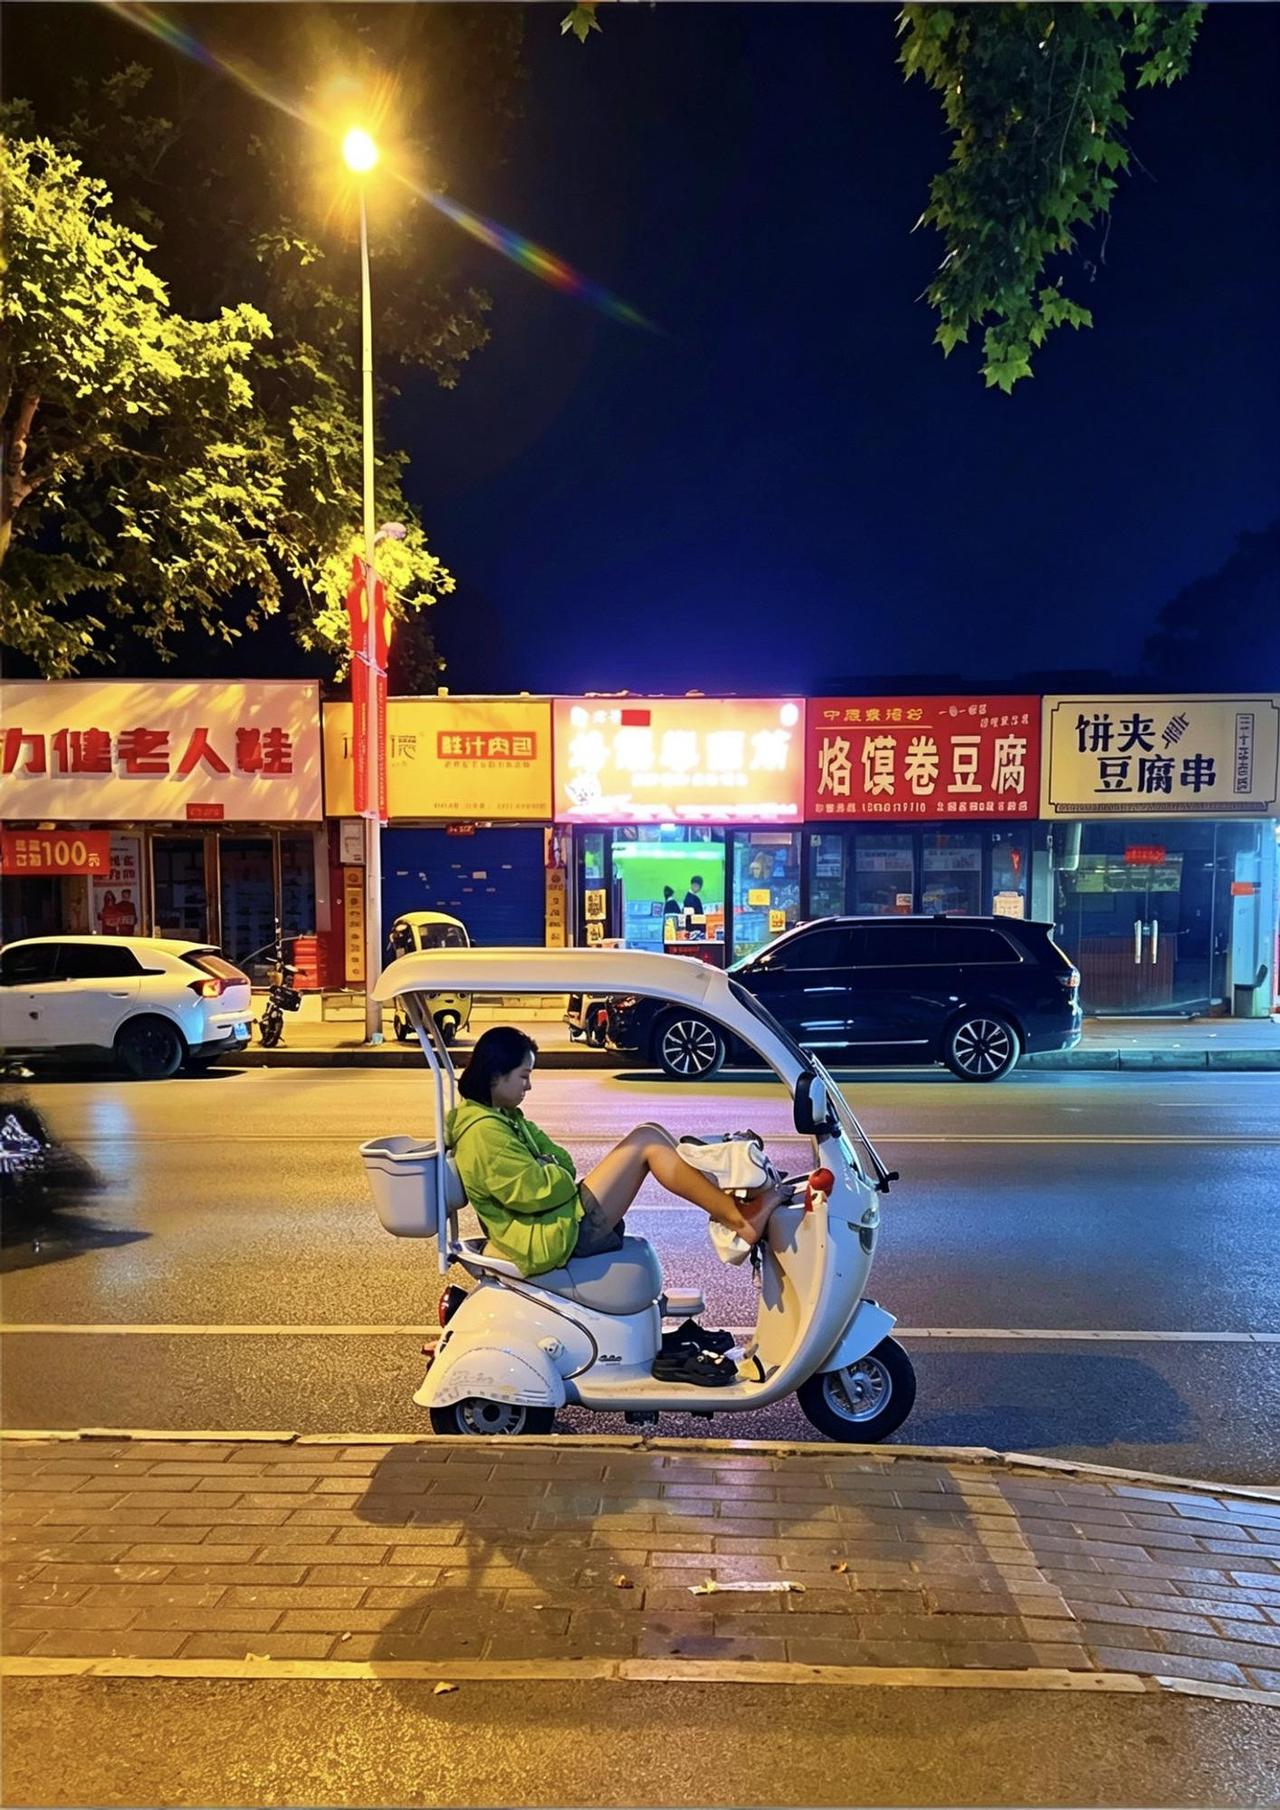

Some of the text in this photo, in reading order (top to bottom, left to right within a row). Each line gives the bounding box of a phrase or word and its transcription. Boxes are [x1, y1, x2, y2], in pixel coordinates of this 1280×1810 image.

[1, 727, 293, 774] 力健老人鞋
[1074, 712, 1156, 754] 饼夹
[817, 734, 1028, 797] 烙馍卷豆腐
[1094, 753, 1217, 795] 豆腐串
